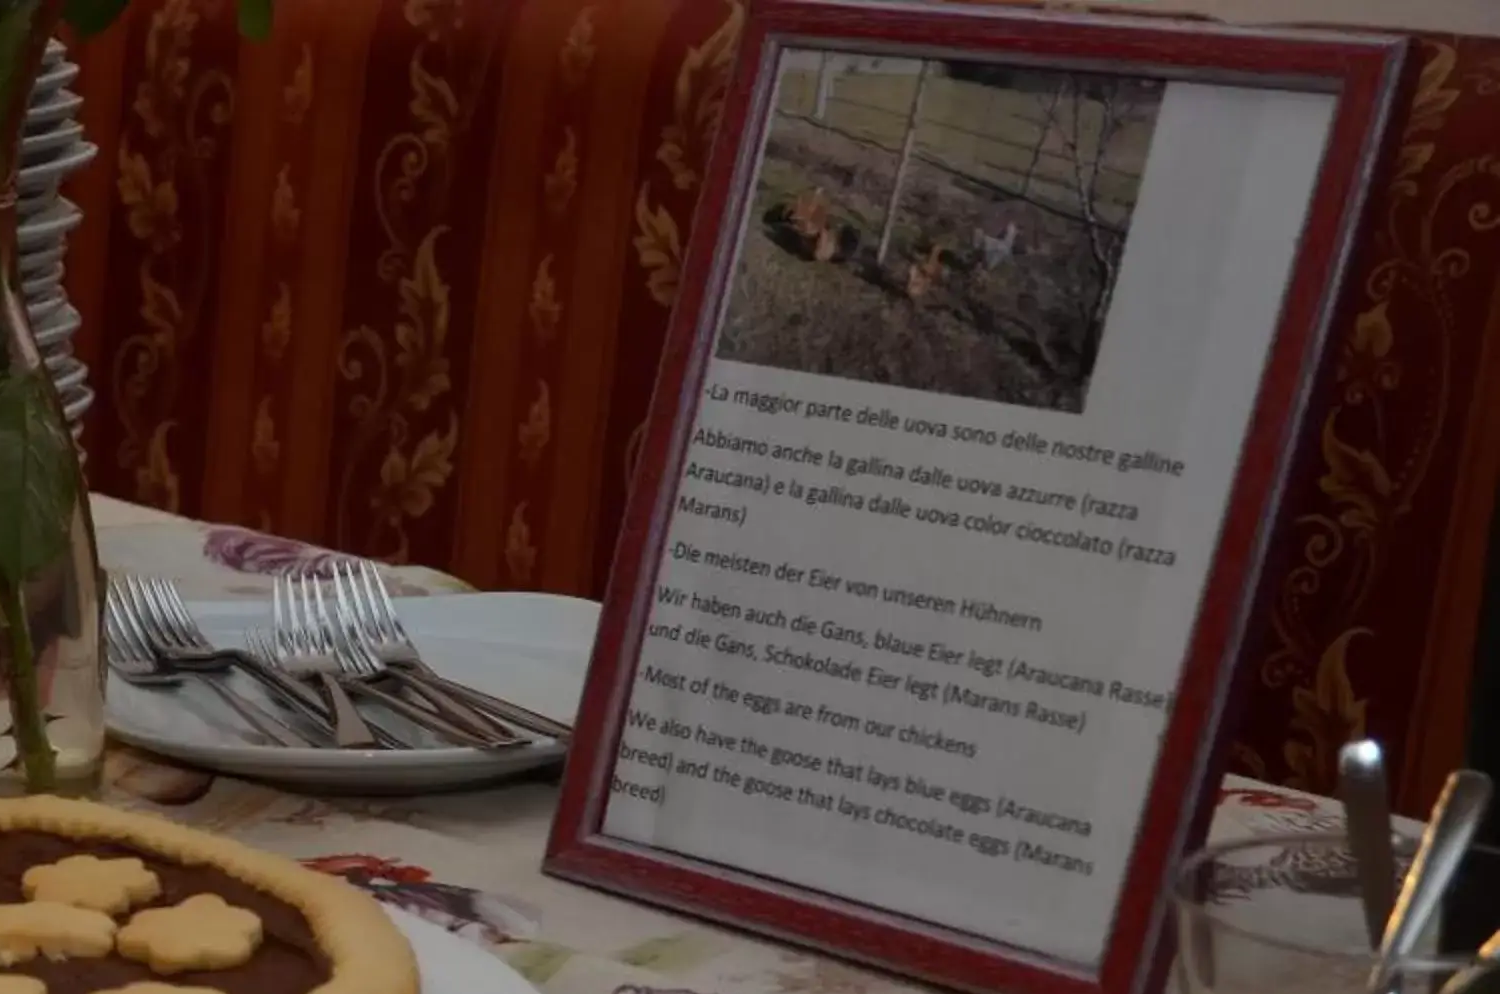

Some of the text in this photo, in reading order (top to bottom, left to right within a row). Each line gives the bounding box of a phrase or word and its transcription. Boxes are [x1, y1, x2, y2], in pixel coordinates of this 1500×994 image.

[692, 427, 1138, 521] Abbiamo anche la gallina dalle uova azzurre (razza
[733, 390, 802, 415] maggior
[804, 402, 853, 422] parte
[856, 407, 900, 430] delle
[904, 418, 948, 438] uova
[951, 425, 997, 446] sono
[1001, 430, 1048, 454] delle
[1051, 441, 1115, 465] nostre
[1117, 452, 1185, 477] galline
[678, 495, 747, 528] Marans)
[685, 461, 1176, 567] Araucana) e la gallina dalle uova color cioccolato (razza
[704, 551, 771, 577] meisten
[774, 562, 805, 583] der
[808, 568, 842, 590] Eier
[846, 581, 879, 598] von
[882, 588, 956, 614] unseren
[959, 599, 1042, 631] Hühnern
[648, 624, 682, 641] und
[684, 628, 711, 649] die
[763, 644, 862, 682] Schokolade
[866, 666, 902, 689] Eier
[905, 675, 939, 701] legt
[1025, 701, 1086, 734] Rasse)
[658, 585, 688, 606] Wir
[691, 592, 741, 619] haben
[744, 608, 787, 629] auch
[790, 615, 817, 635] die
[873, 630, 925, 658] blaue
[928, 643, 964, 665] Eier
[967, 650, 1003, 678] legt
[1007, 660, 1104, 697] (Araucana
[689, 678, 710, 695] of
[713, 683, 740, 703] the
[742, 692, 781, 715] eggs
[784, 701, 814, 720] are
[817, 704, 860, 730] from
[864, 720, 896, 738] our
[898, 725, 976, 758] chickens
[611, 776, 665, 807] breed)
[619, 741, 673, 774] breed)
[676, 759, 710, 779] and
[713, 766, 742, 788] the
[743, 776, 794, 801] goose
[797, 787, 834, 811] that
[837, 795, 871, 821] lays
[874, 808, 965, 843] chocolate
[968, 833, 1010, 857] eggs
[628, 709, 1092, 837] We also have the goose that lays blue eggs (Araucana
